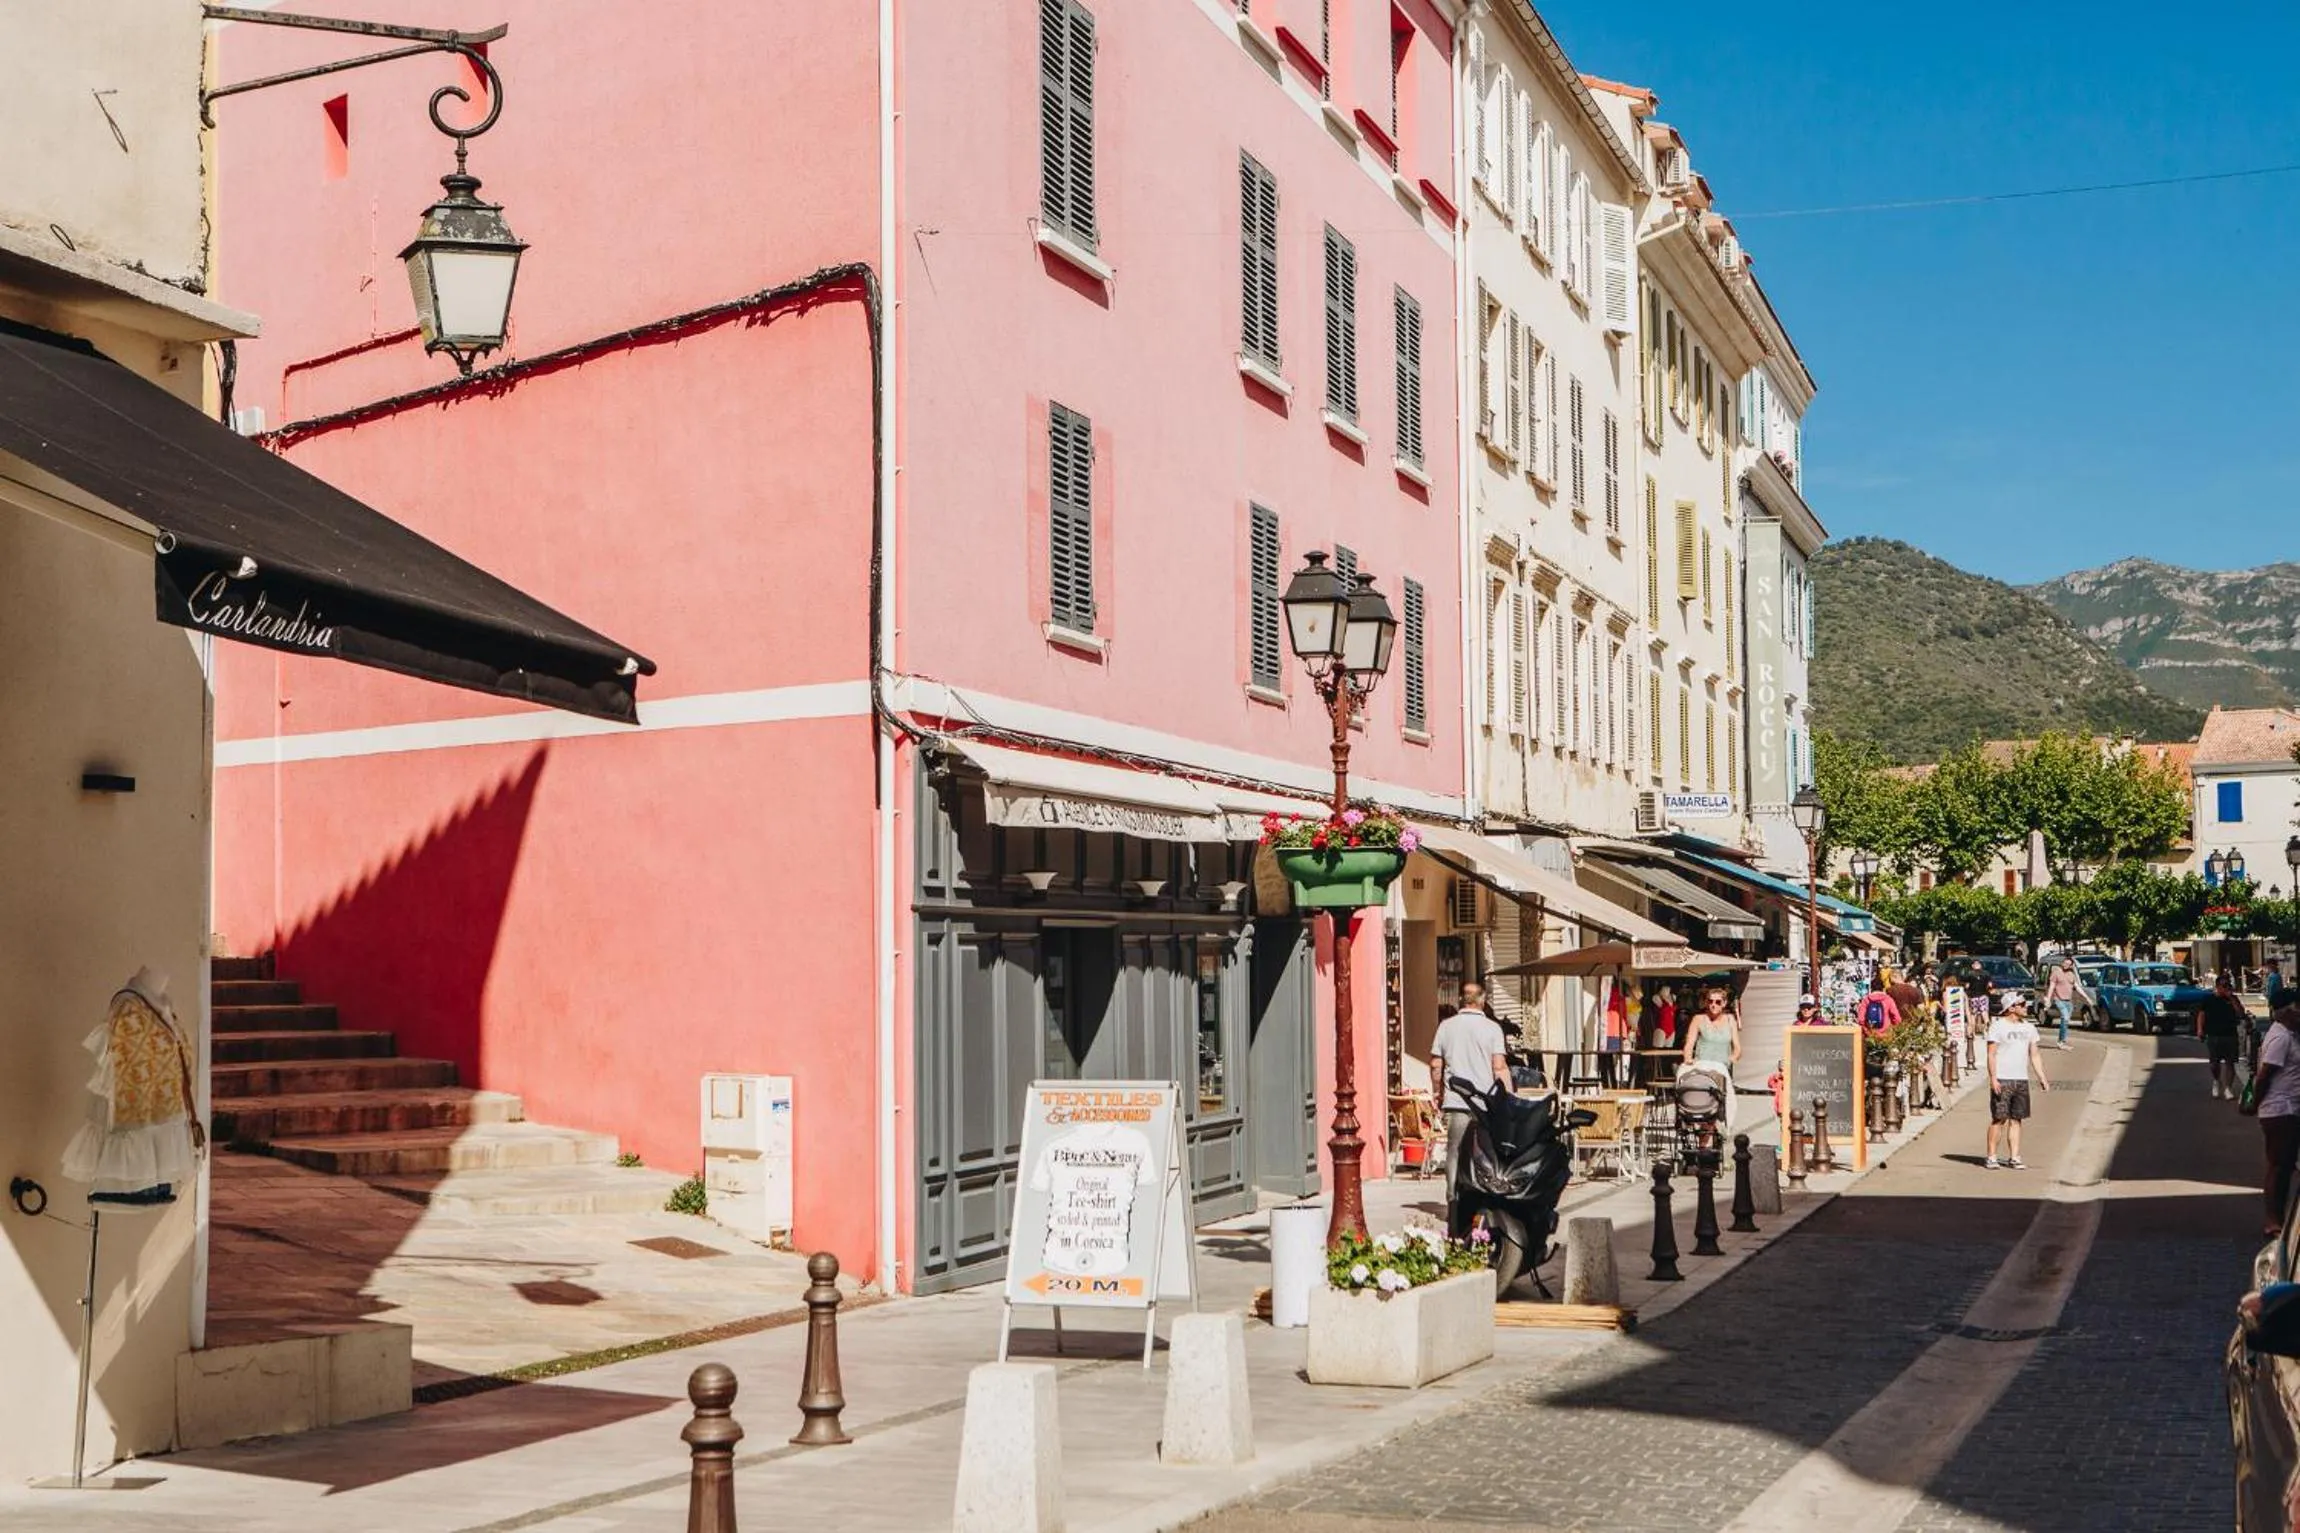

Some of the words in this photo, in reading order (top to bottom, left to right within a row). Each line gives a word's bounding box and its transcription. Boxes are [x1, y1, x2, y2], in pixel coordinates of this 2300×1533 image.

[187, 570, 333, 648] Carlandria
[1757, 576, 1773, 639] SAN
[1665, 796, 1729, 807] TAMARELLA
[1040, 1091, 1163, 1107] TEXTILES
[1060, 1231, 1072, 1248] in
[1074, 1231, 1114, 1249] Corsica
[1047, 1279, 1082, 1291] 20
